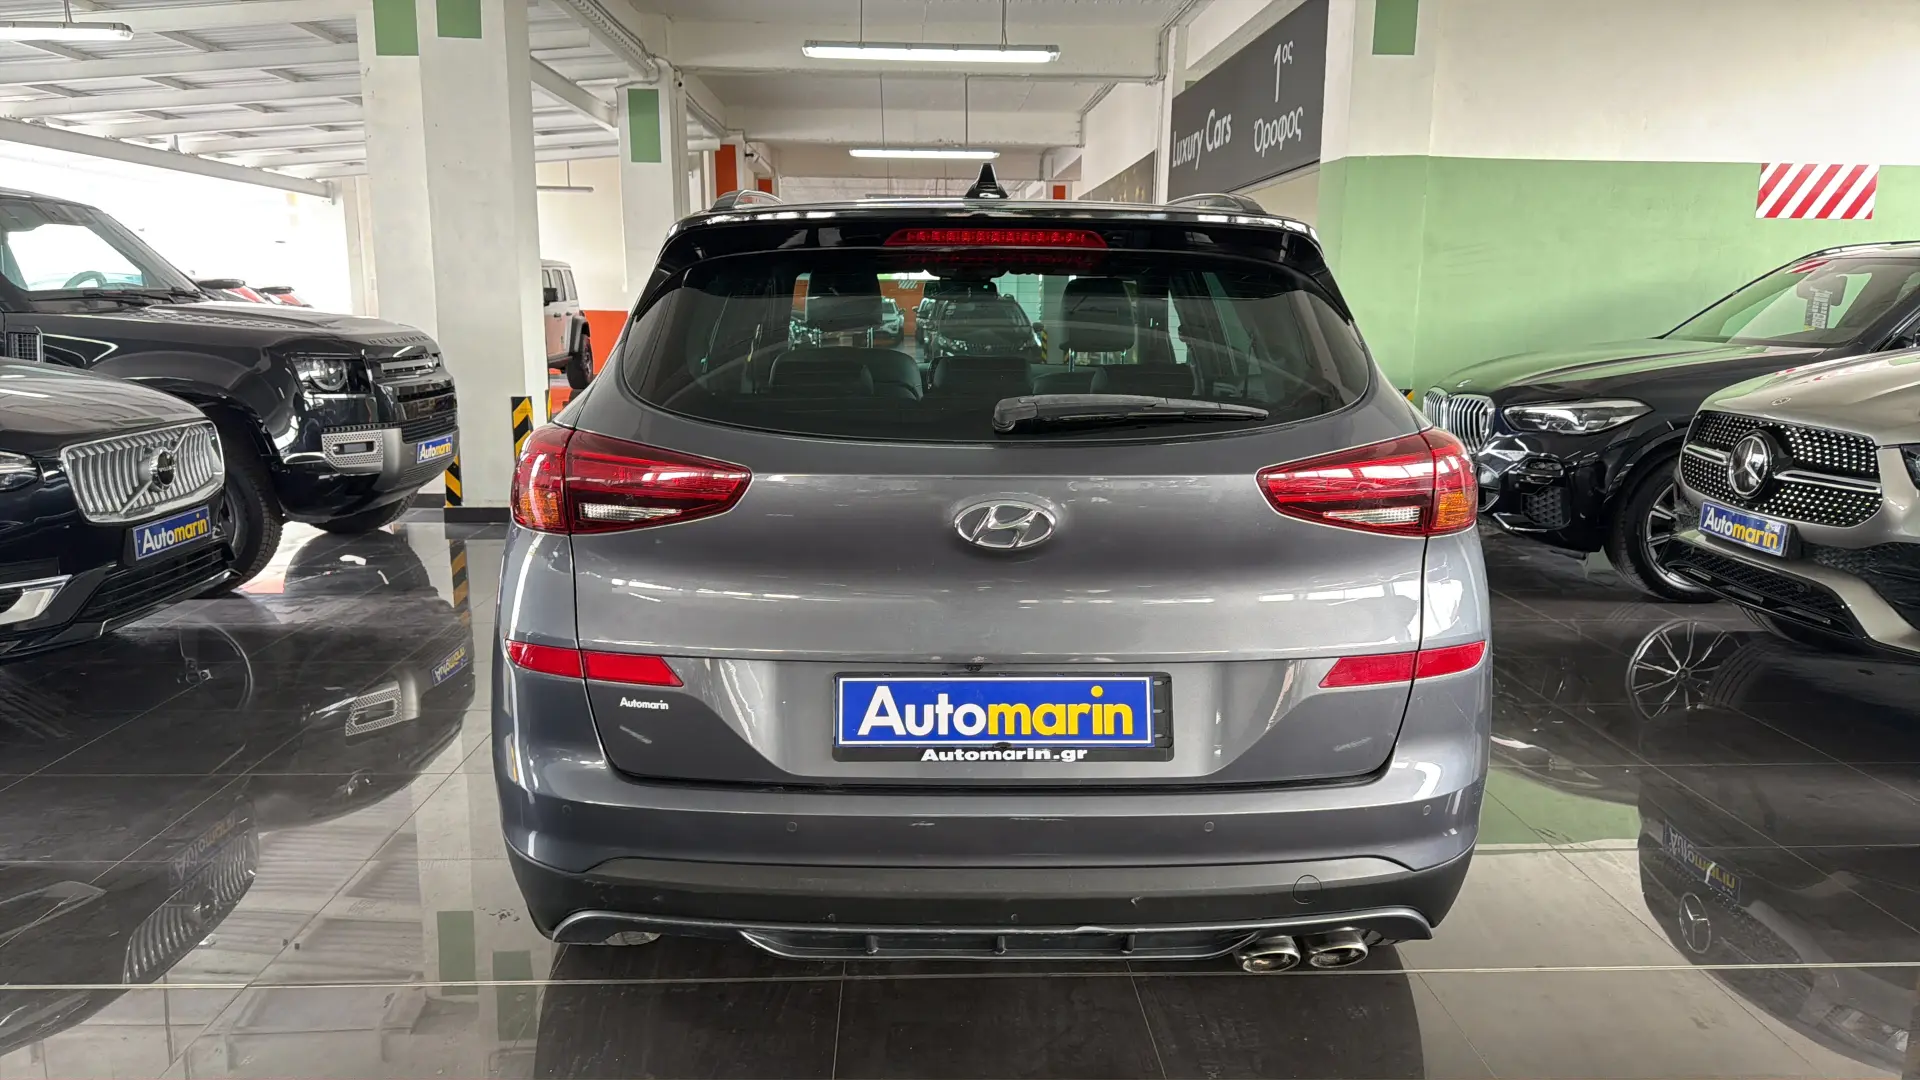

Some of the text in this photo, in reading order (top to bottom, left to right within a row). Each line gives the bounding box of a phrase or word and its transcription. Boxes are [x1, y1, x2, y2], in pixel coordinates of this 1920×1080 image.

[1172, 108, 1232, 171] Luxury Cars
[420, 437, 451, 461] Automarin
[142, 512, 208, 555] Automarin
[1703, 507, 1779, 550] Automarin
[619, 696, 669, 710] Automarin
[857, 685, 1133, 736] Automarin
[920, 747, 1088, 763] Automarin.gr
